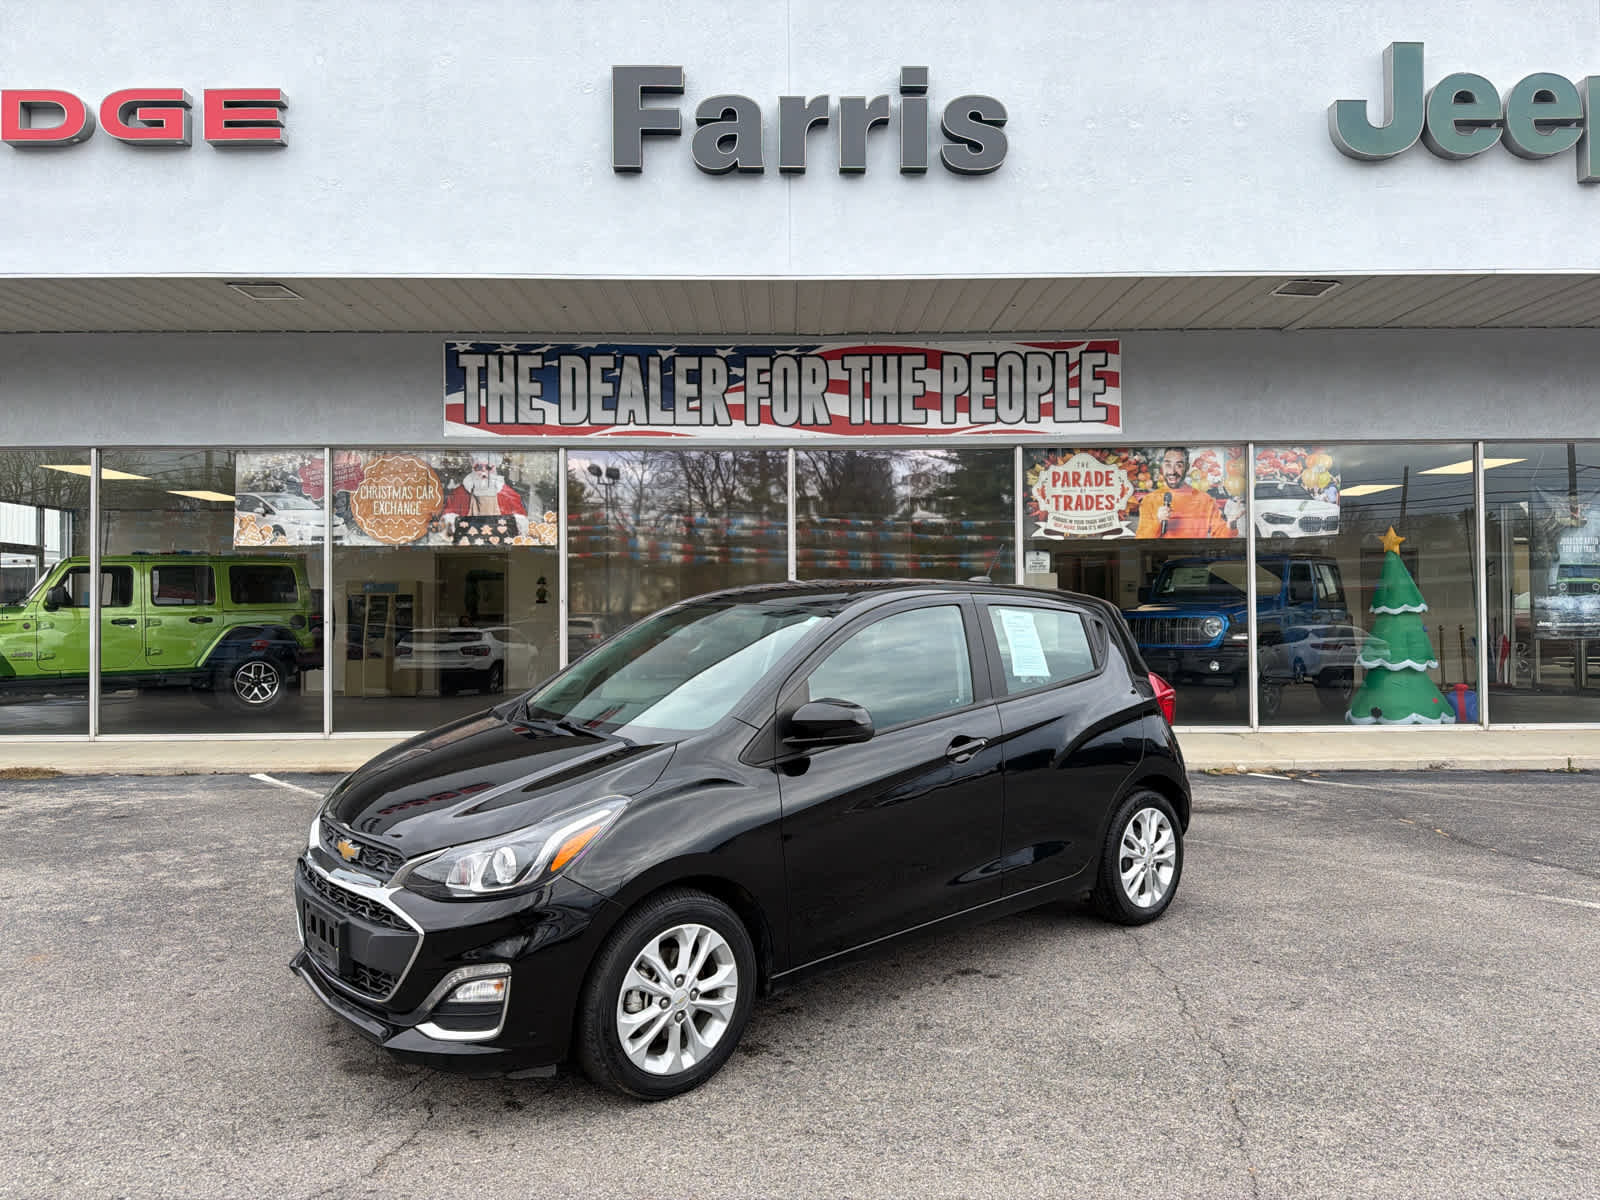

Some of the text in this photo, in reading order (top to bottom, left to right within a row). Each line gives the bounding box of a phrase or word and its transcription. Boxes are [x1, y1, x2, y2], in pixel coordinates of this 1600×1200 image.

[1, 88, 288, 147] DGE
[611, 65, 1009, 175] Farris
[1328, 42, 1600, 184] Jee
[457, 350, 1108, 426] THE DEALER FOR THE PEOPLE
[360, 485, 435, 500] CHRISTMAS CAR
[1051, 470, 1115, 488] PARADE
[373, 501, 422, 516] EXCHANGE
[1051, 494, 1115, 511] TRADES
